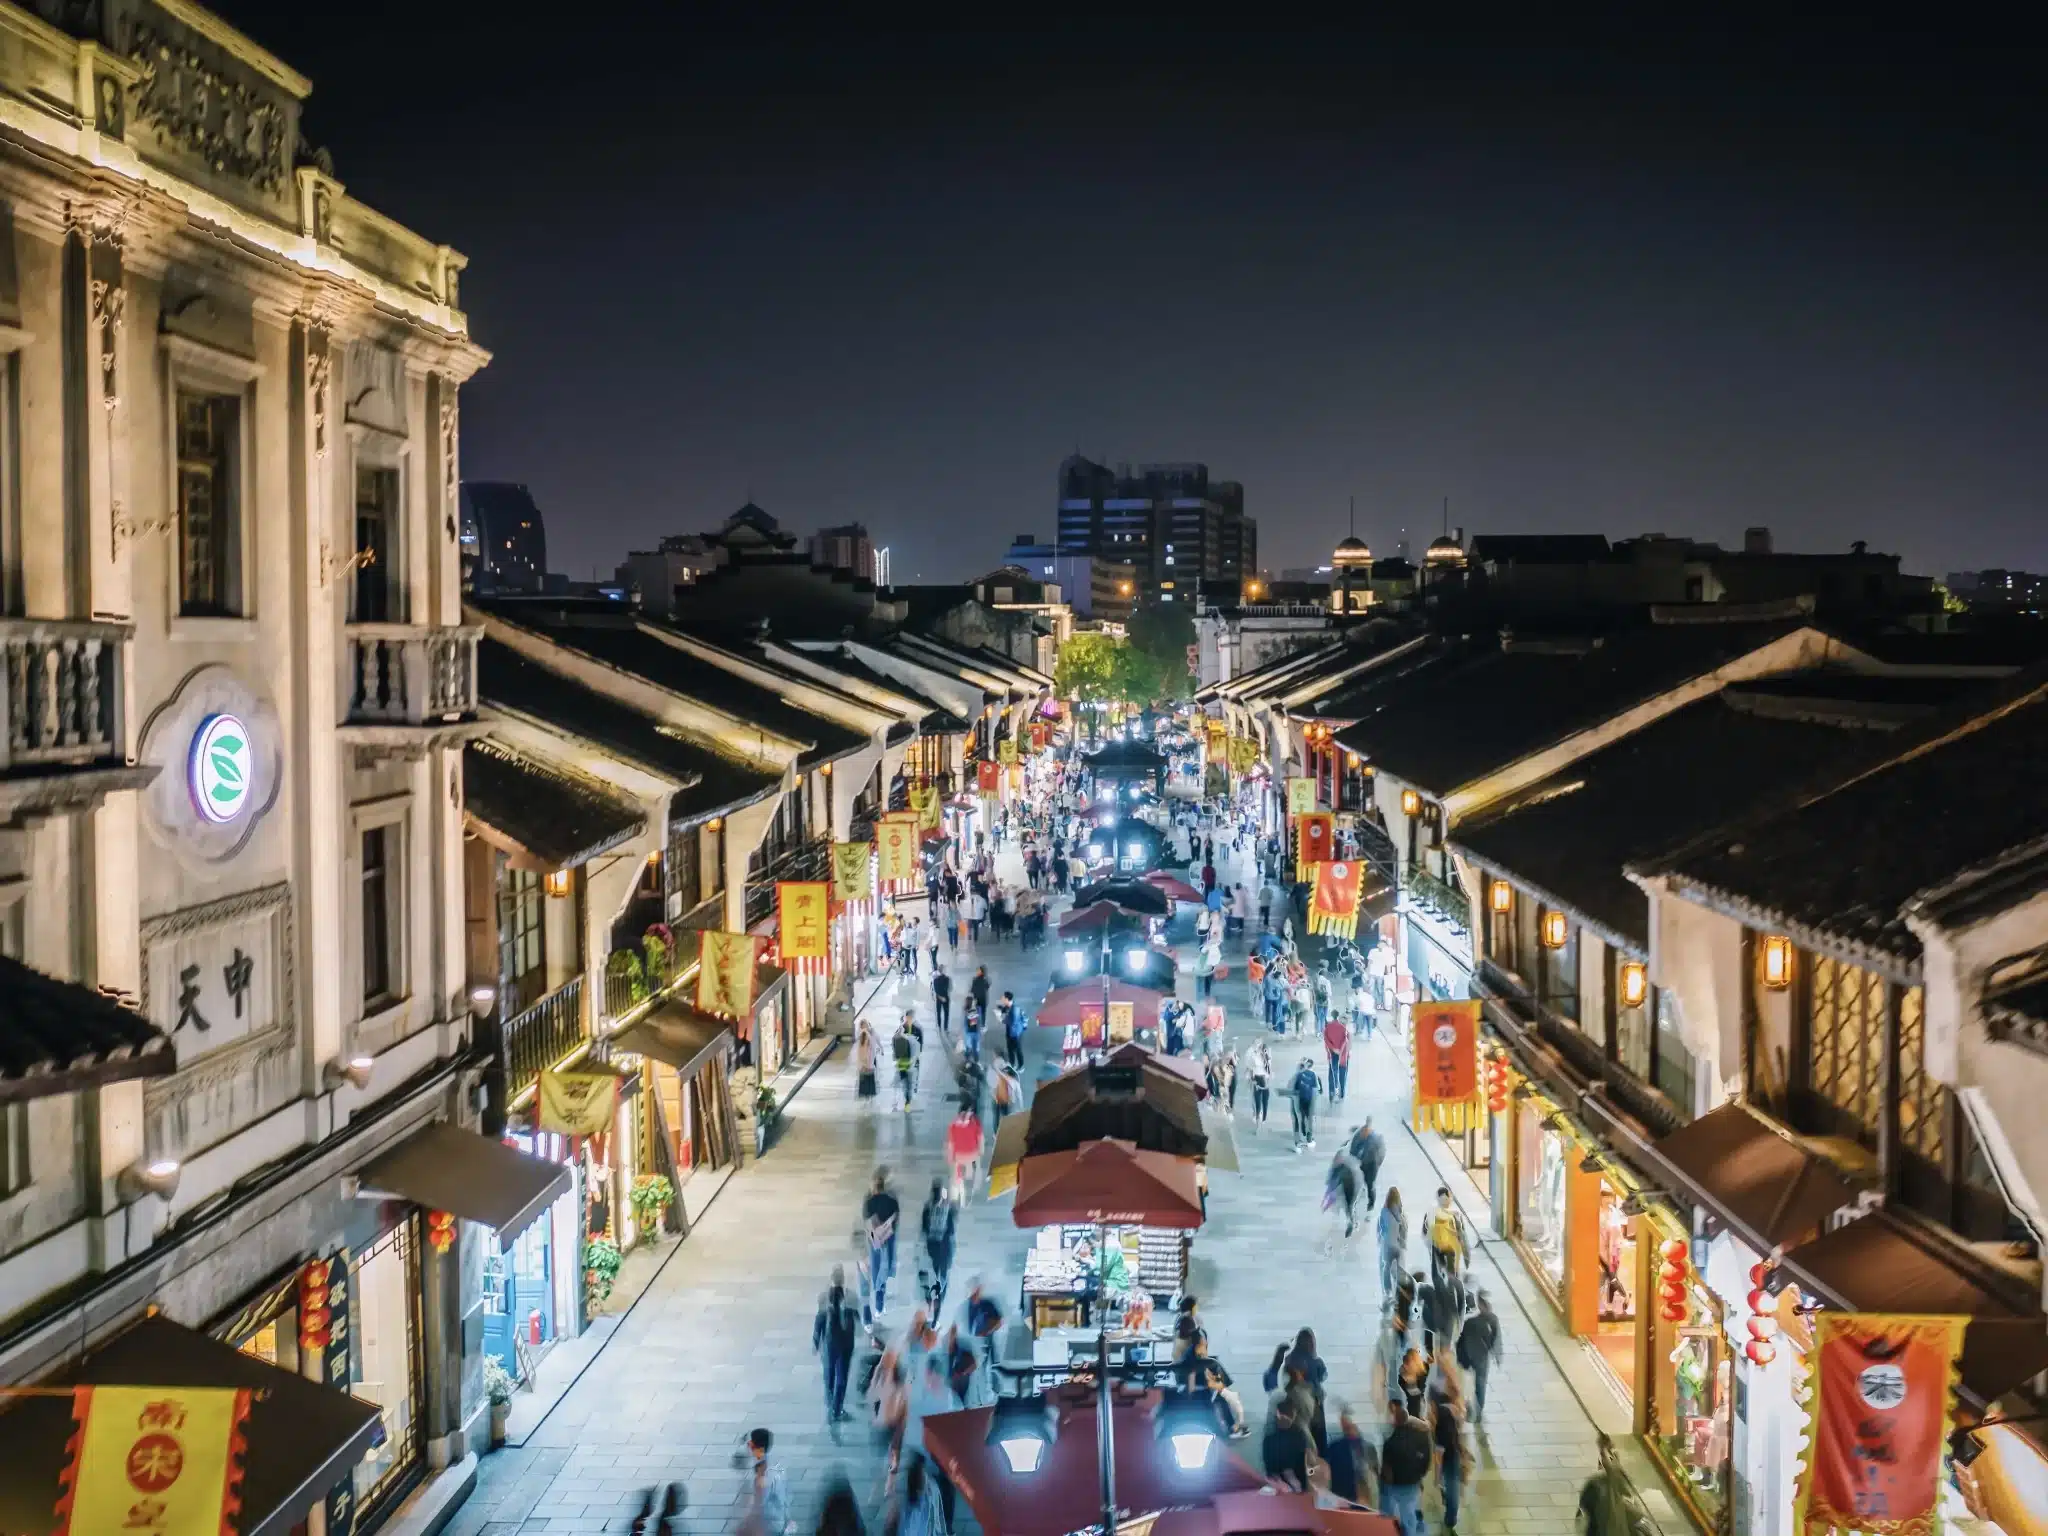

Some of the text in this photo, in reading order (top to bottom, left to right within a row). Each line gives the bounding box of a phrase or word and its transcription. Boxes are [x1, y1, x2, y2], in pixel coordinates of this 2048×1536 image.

[329, 1279, 348, 1394] 欲把西
[121, 1398, 190, 1536] 南宋皇
